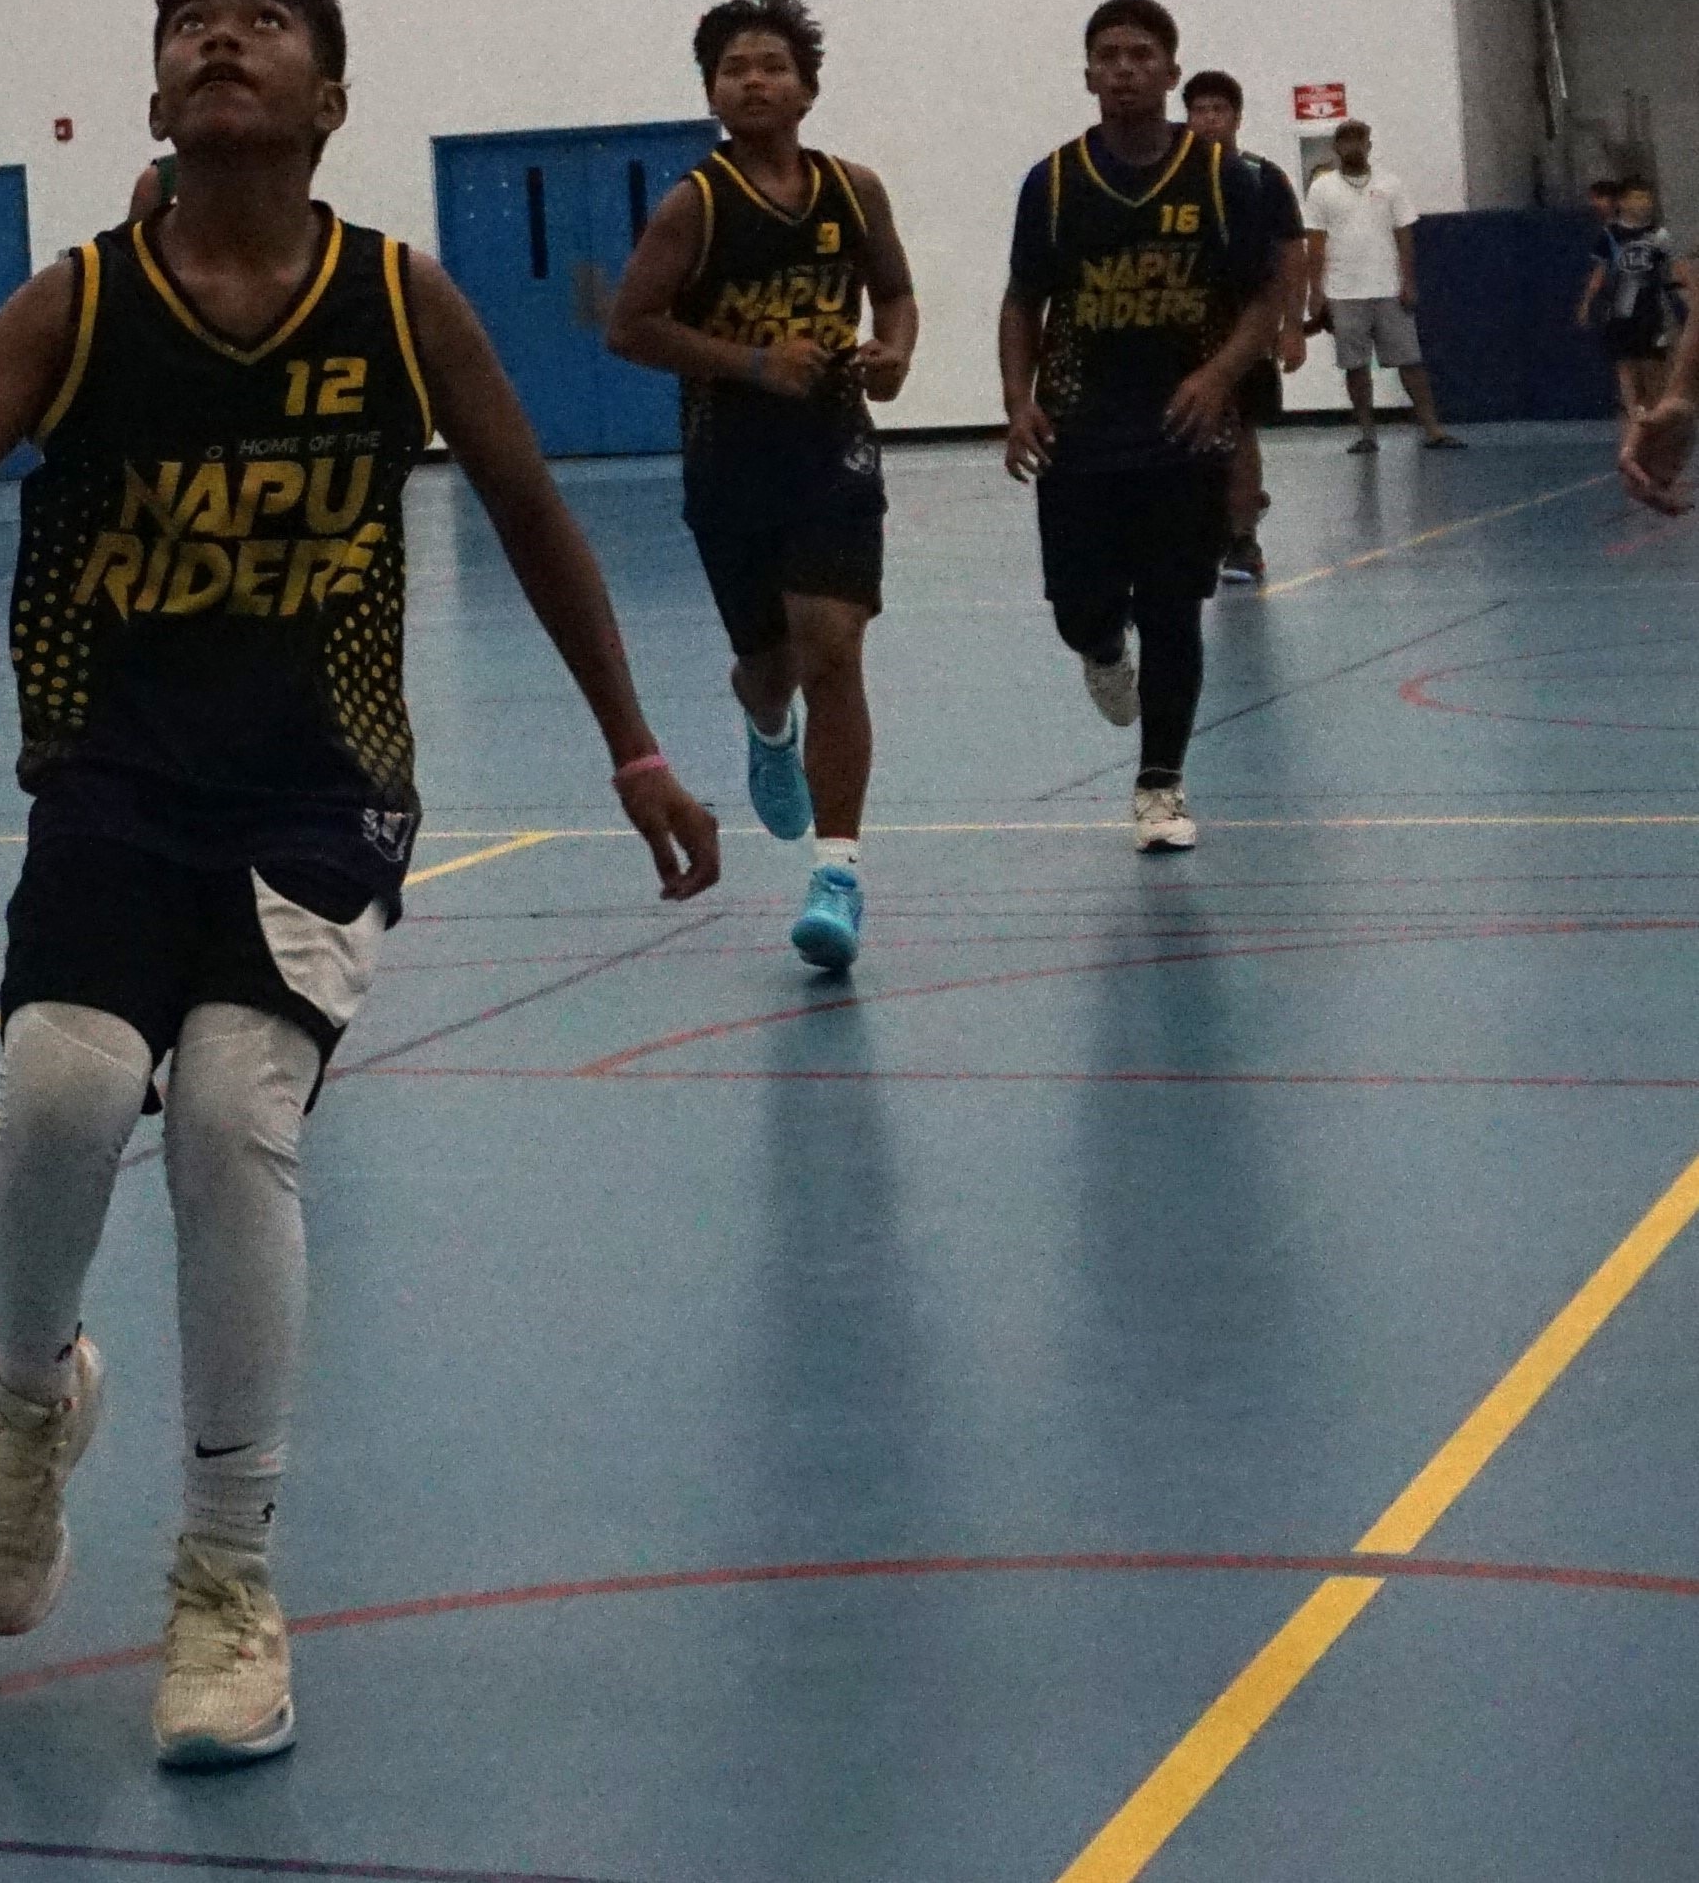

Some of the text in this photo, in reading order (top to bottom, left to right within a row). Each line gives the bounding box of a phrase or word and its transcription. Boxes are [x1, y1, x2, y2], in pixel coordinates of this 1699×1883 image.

[815, 221, 841, 254] 9
[1160, 203, 1200, 234] 16
[285, 356, 368, 417] 12
[119, 454, 375, 538] NAPU
[70, 521, 388, 622] RIDERS
